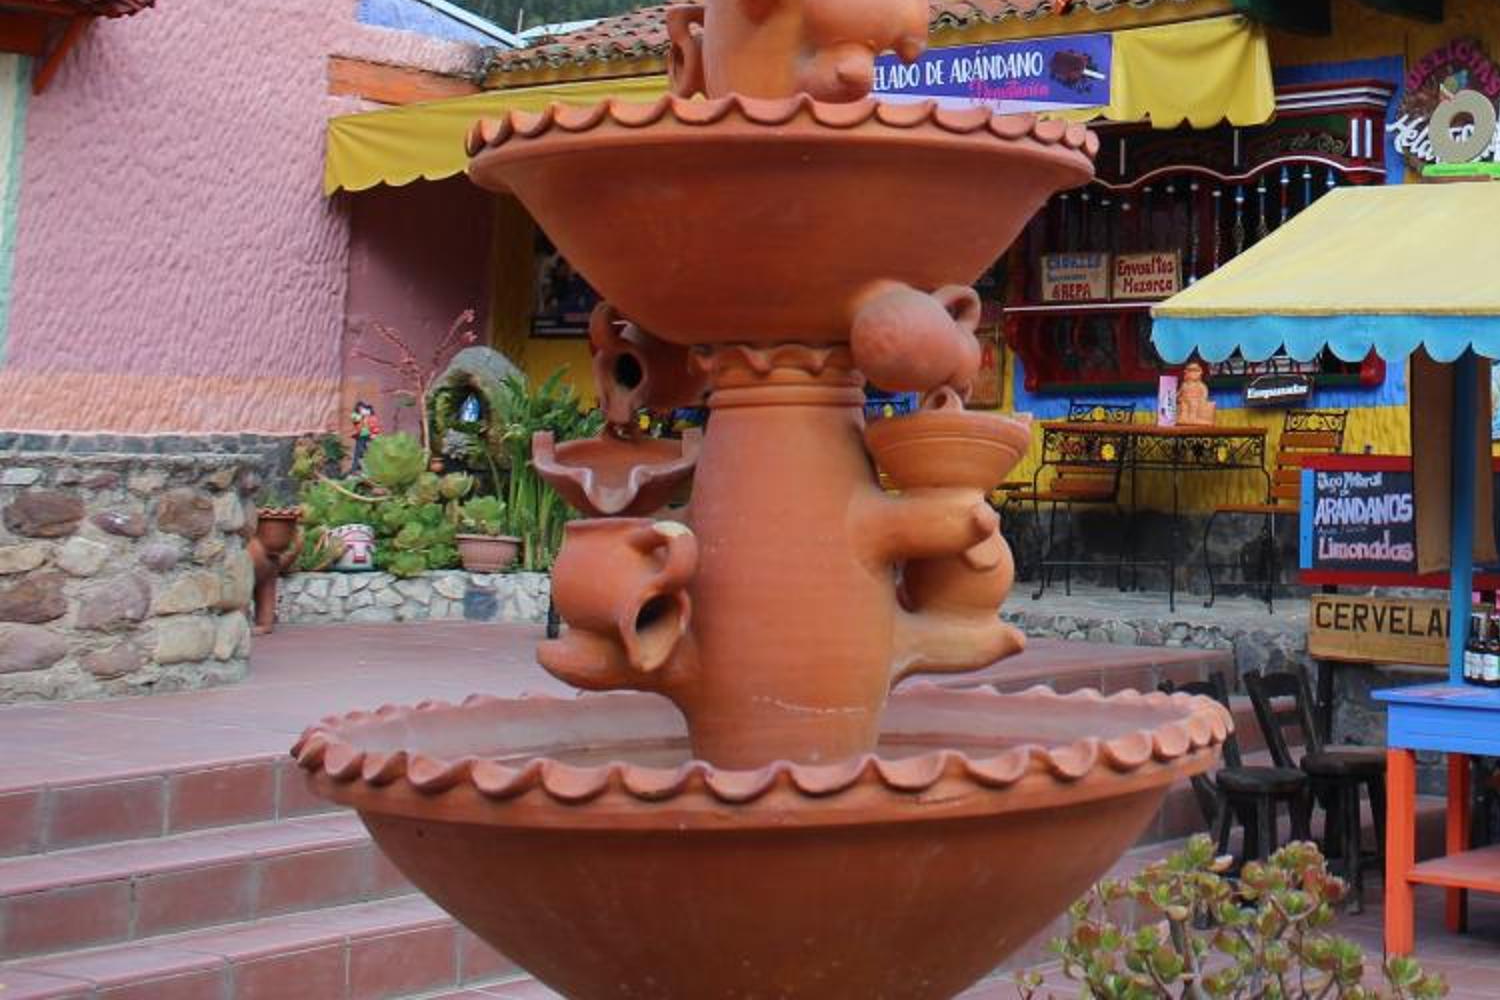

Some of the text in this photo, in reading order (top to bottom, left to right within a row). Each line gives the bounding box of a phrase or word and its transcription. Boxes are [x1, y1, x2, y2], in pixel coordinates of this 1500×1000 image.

[873, 50, 1043, 91] ELADO DE ARÁNDANO
[1318, 530, 1414, 562] Limonadas
[1316, 602, 1451, 638] CERVELA
